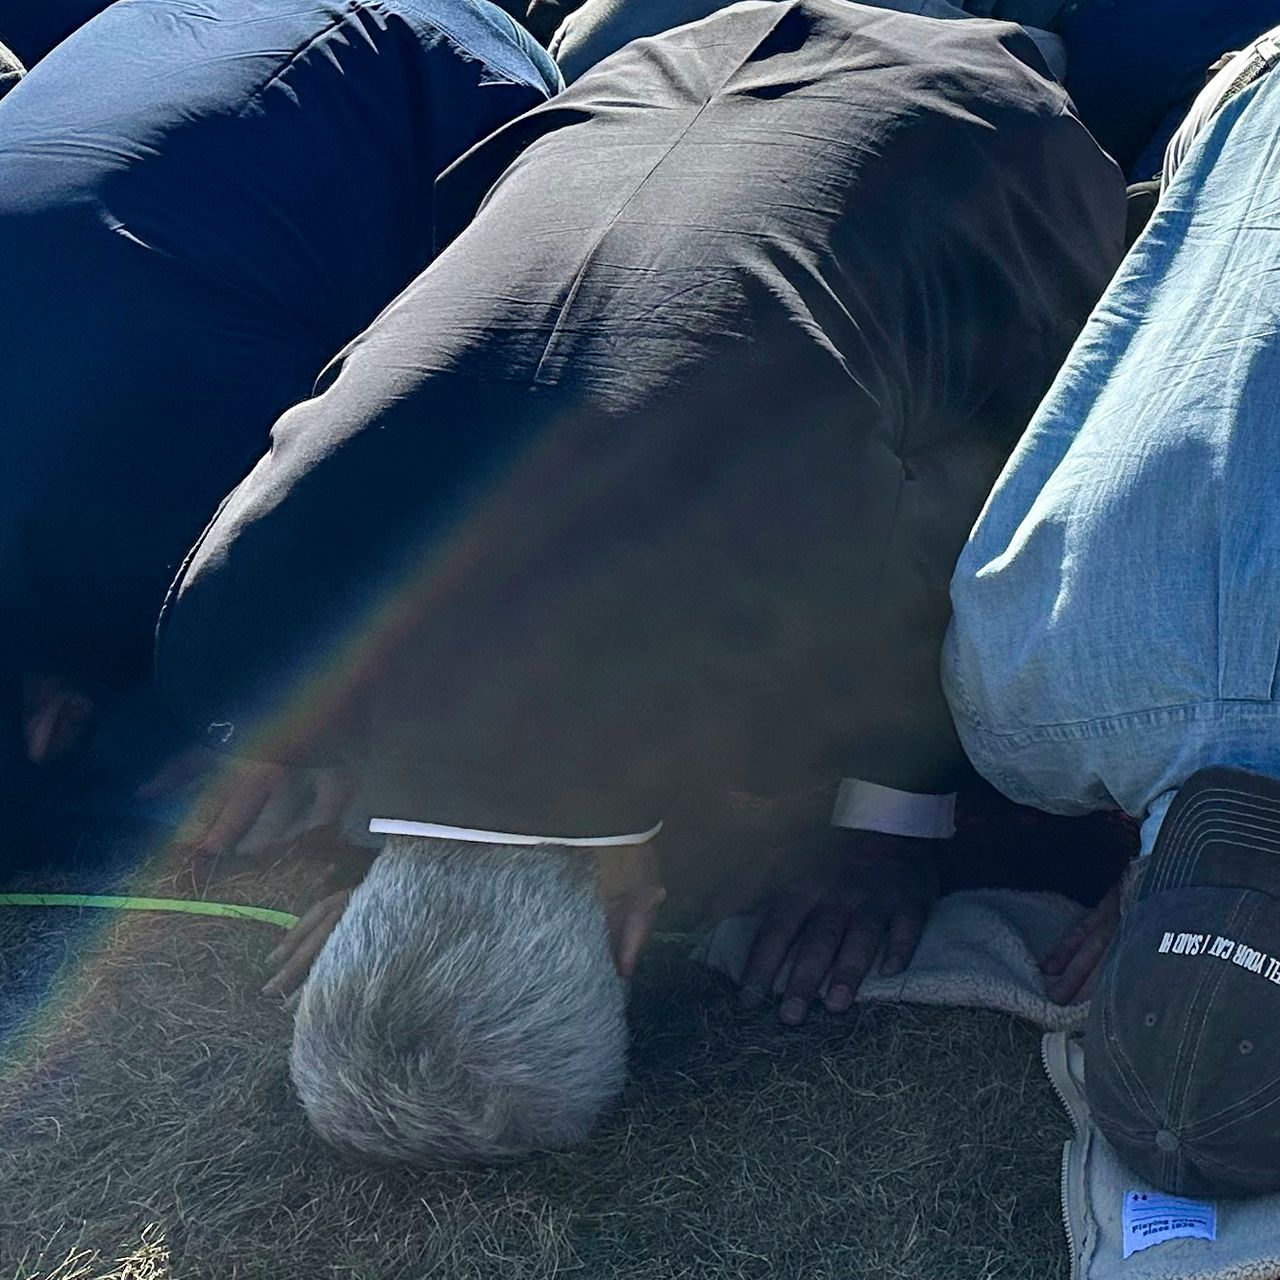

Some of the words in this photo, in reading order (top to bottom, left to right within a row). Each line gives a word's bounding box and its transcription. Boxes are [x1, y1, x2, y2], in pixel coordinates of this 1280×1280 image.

[1158, 931, 1175, 954] HI
[1171, 933, 1203, 956] SAID
[1200, 934, 1211, 954] I
[1208, 936, 1235, 960] CAT
[1231, 943, 1267, 974] YOUR
[1131, 1219, 1169, 1233] Playing
